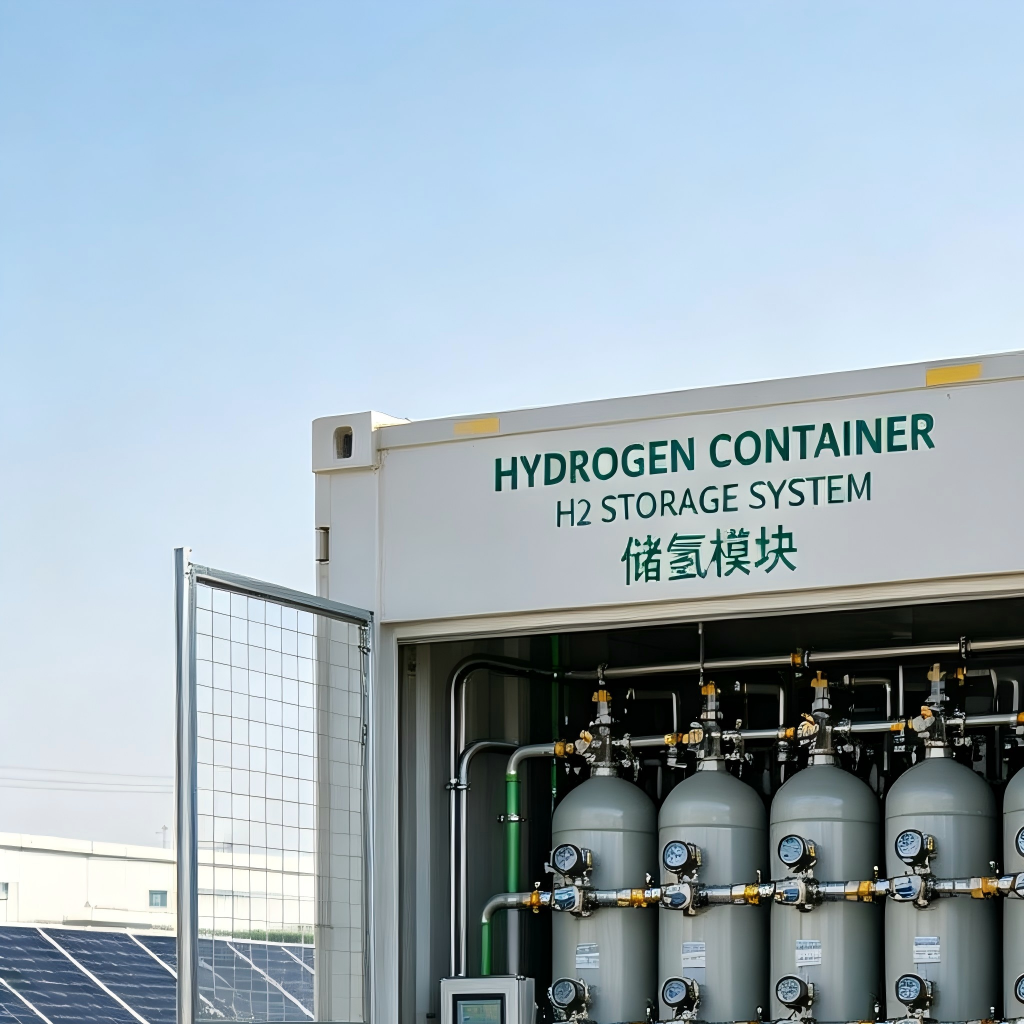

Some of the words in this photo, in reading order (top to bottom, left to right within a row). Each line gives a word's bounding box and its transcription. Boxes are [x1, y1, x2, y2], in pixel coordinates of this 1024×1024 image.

[494, 437, 695, 491] HYDROGEN
[709, 412, 936, 468] CONTAINER
[556, 498, 592, 527] H2
[601, 483, 739, 523] STORAGE
[748, 471, 873, 510] SYSTEM
